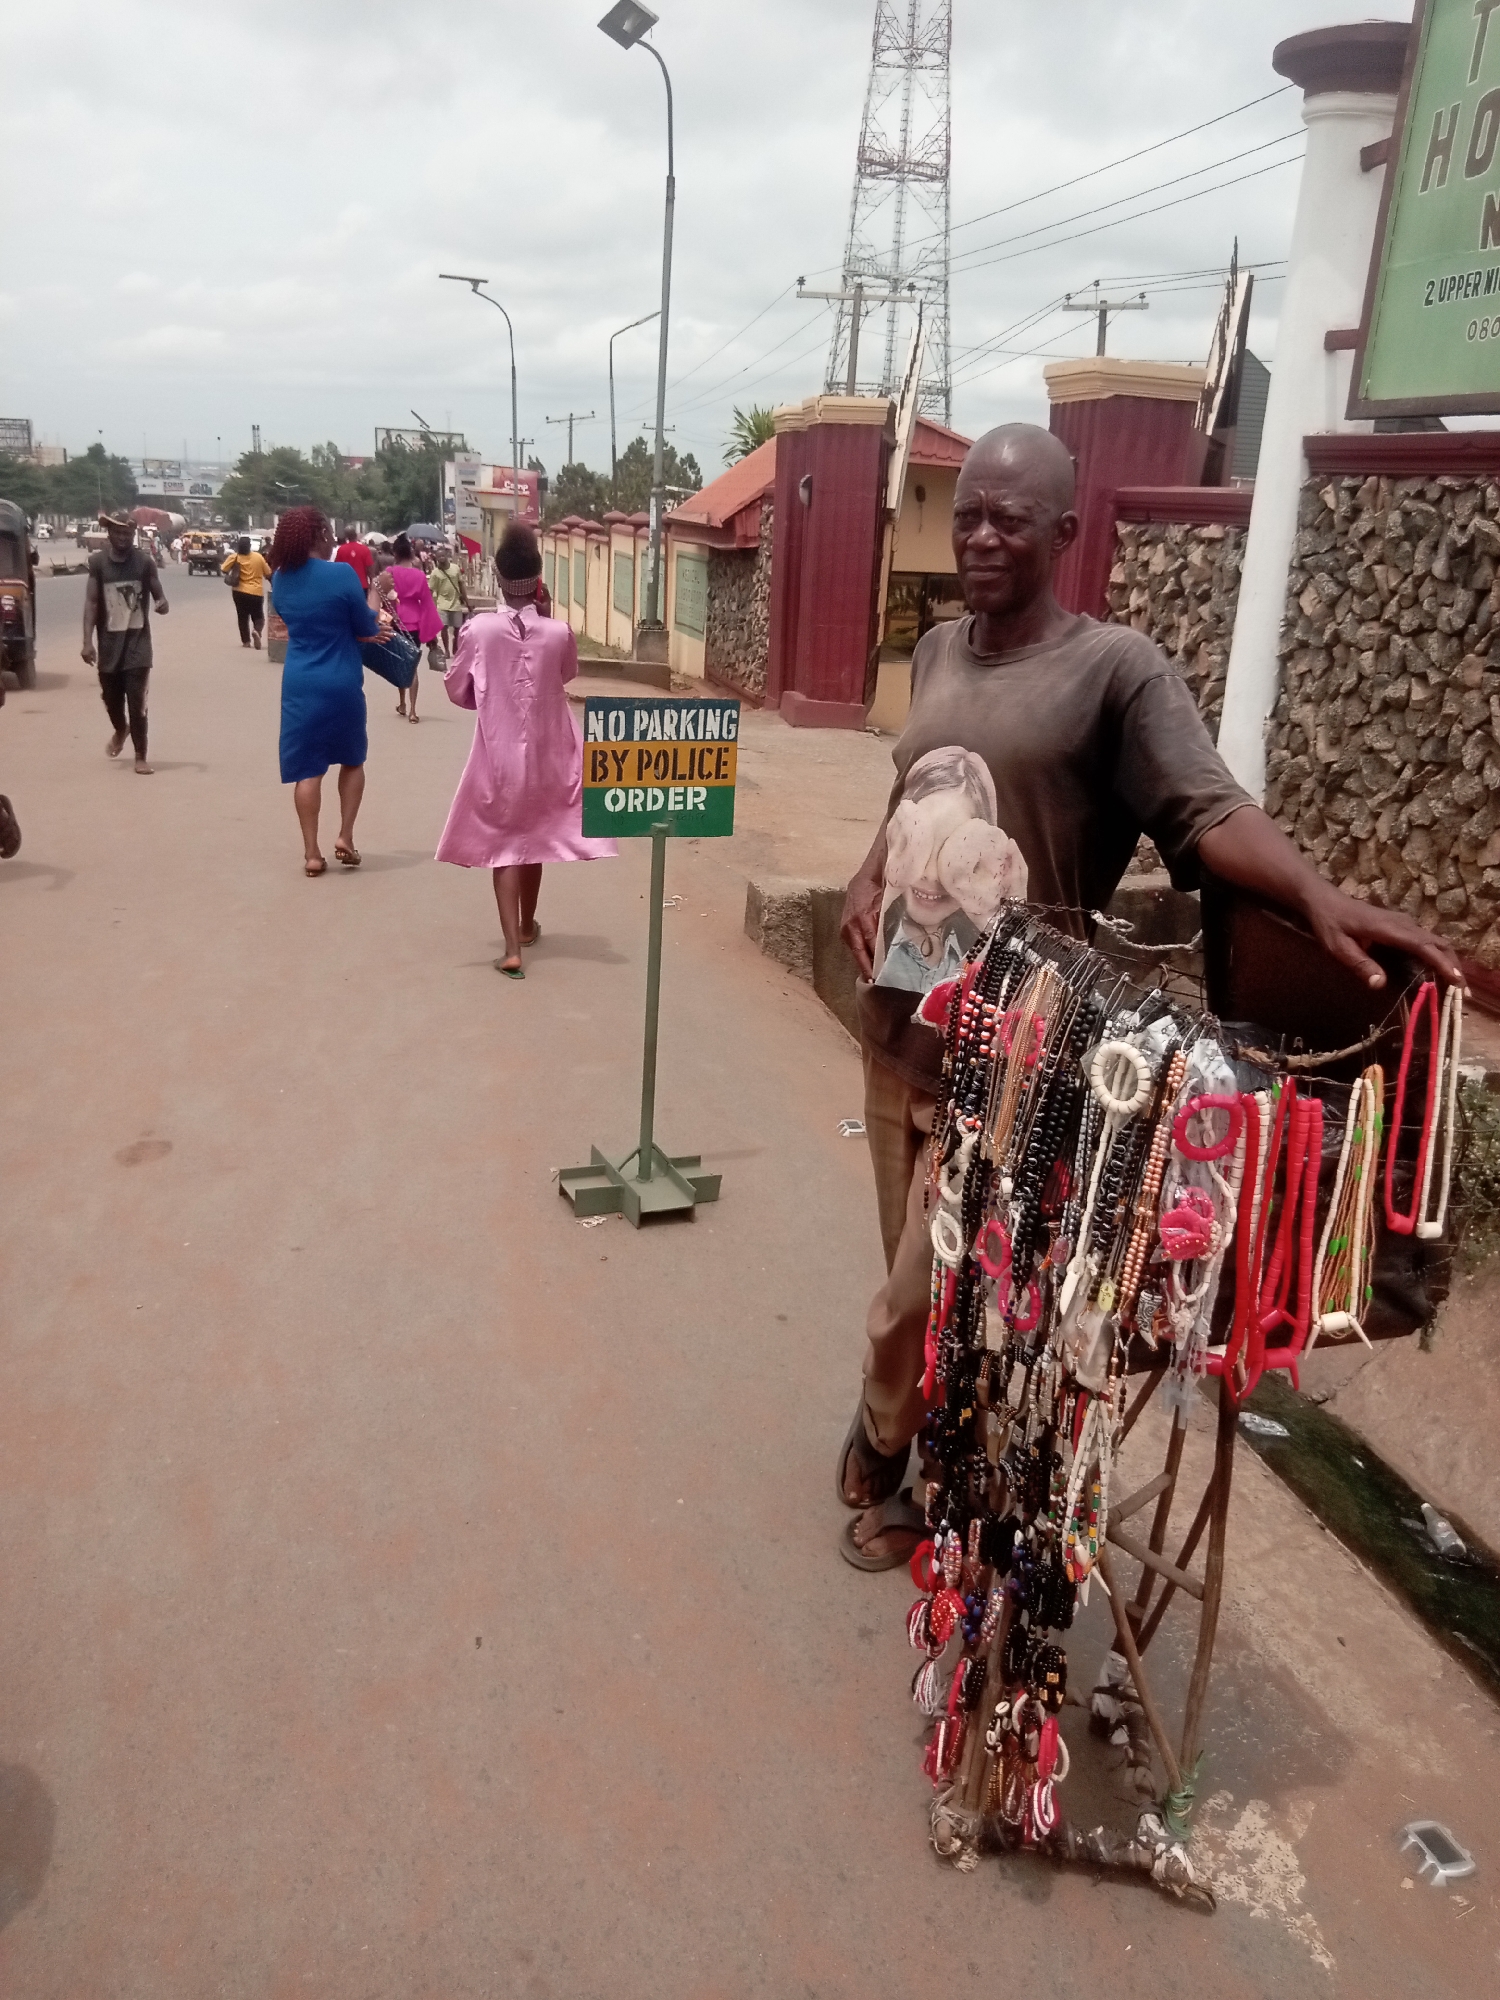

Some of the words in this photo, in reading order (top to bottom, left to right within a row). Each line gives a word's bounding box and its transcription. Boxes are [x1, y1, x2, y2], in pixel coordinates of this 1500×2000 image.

[1424, 279, 1436, 307] 2
[1437, 270, 1482, 304] UPPER
[587, 710, 626, 742] NO
[633, 708, 738, 742] PARKING
[590, 749, 630, 782] BY
[637, 746, 730, 782] POLICE
[604, 786, 708, 813] ORDER
